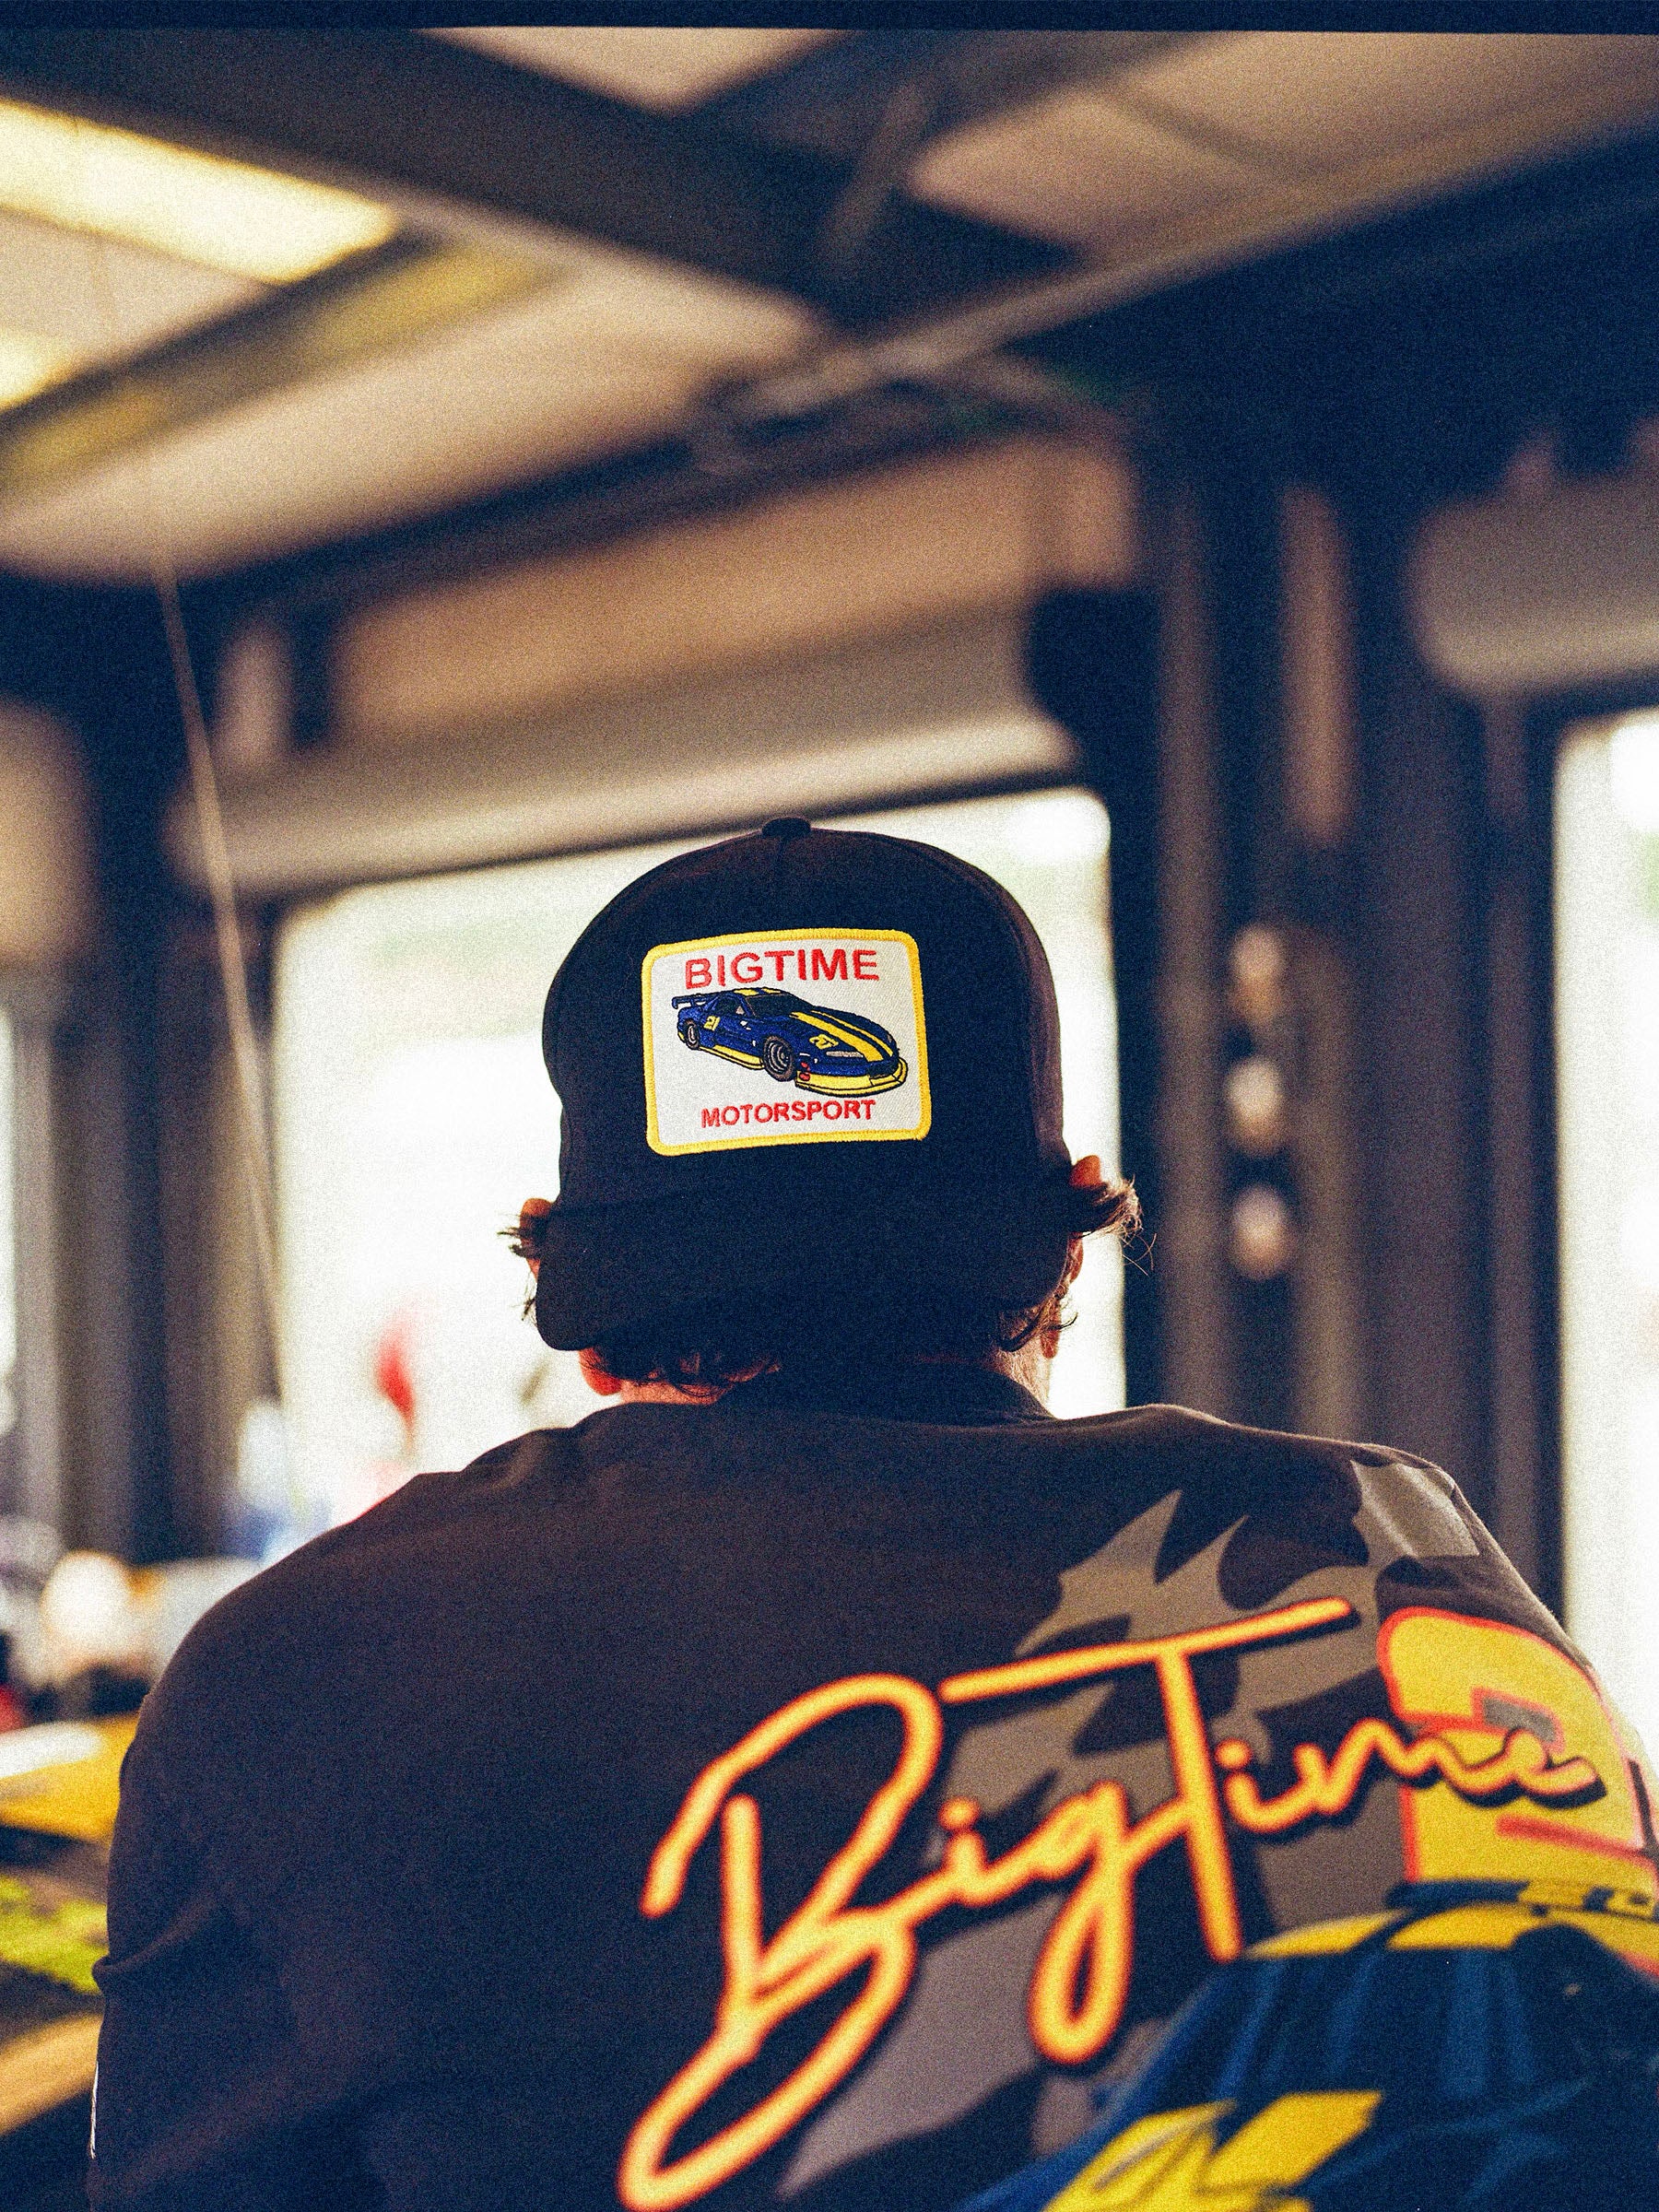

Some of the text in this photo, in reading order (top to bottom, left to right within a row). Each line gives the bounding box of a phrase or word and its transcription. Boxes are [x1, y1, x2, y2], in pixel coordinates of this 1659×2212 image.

[685, 948, 879, 989] BIGTIME
[703, 1015, 721, 1031] 21
[700, 1099, 877, 1128] MOTORSPORT
